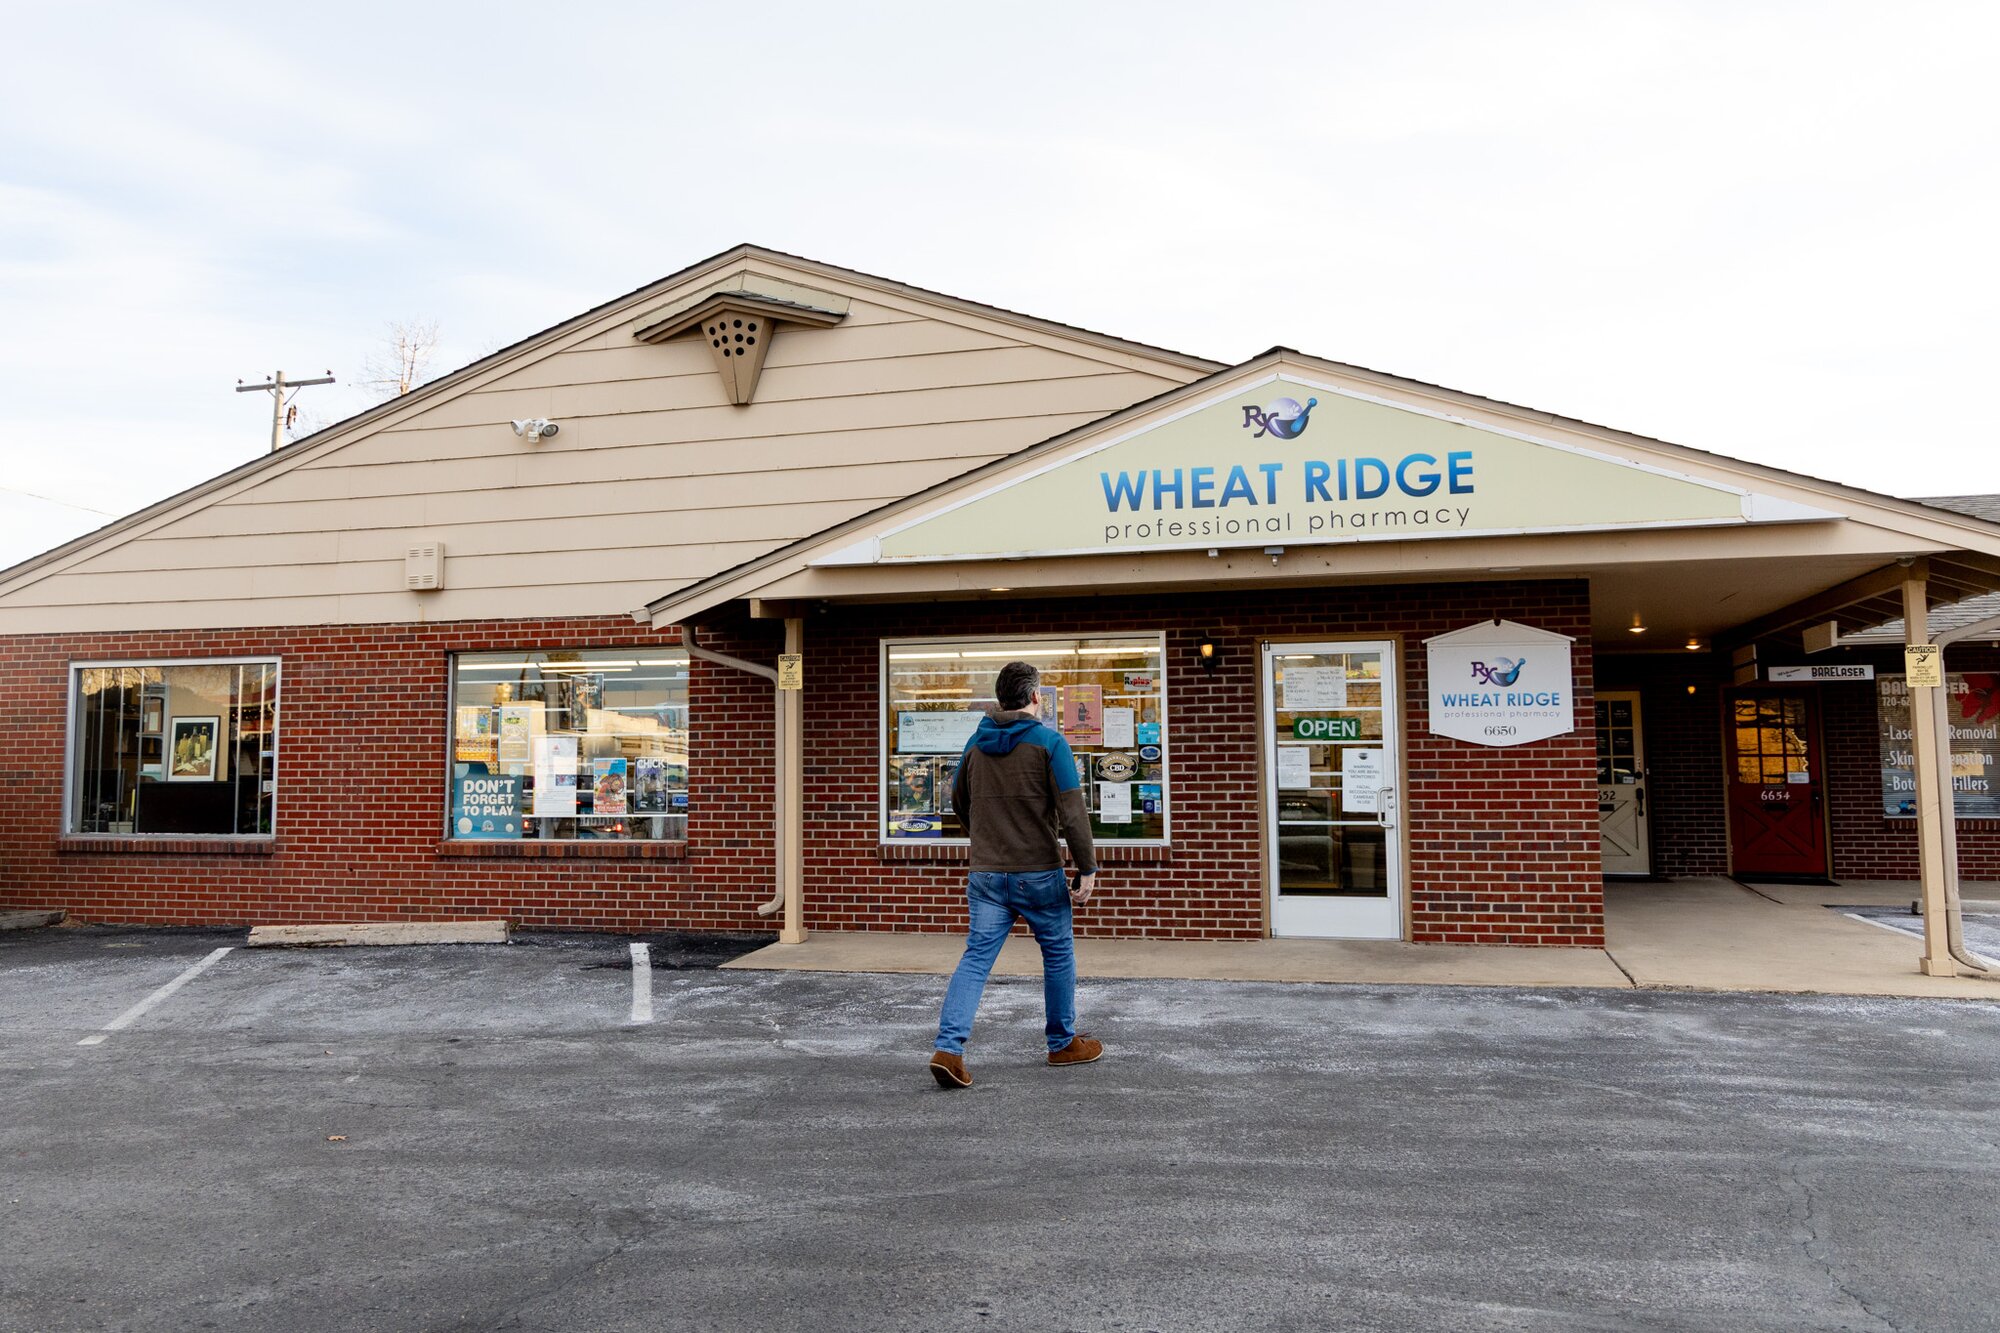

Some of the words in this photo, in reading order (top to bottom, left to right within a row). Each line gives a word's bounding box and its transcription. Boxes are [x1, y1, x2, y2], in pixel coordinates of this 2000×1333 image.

[1100, 462, 1283, 513] WHEAT
[1304, 450, 1475, 503] RIDGE
[1105, 512, 1291, 544] professional
[1308, 506, 1471, 534] pharmacy
[1811, 667, 1866, 677] BARELASER
[1442, 693, 1501, 707] WHEAT
[1507, 692, 1560, 707] RIDGE
[1444, 710, 1506, 719] professional
[1509, 709, 1561, 719] pharmacy
[1298, 718, 1357, 738] OPEN
[1484, 725, 1517, 737] 6650
[1883, 725, 1913, 740] -Lase
[1949, 724, 1997, 740] Removal
[463, 779, 515, 794] DON'T
[463, 793, 514, 805] FORGET
[1761, 790, 1790, 800] 6654
[462, 805, 480, 816] TO
[483, 805, 514, 816] PLAY
